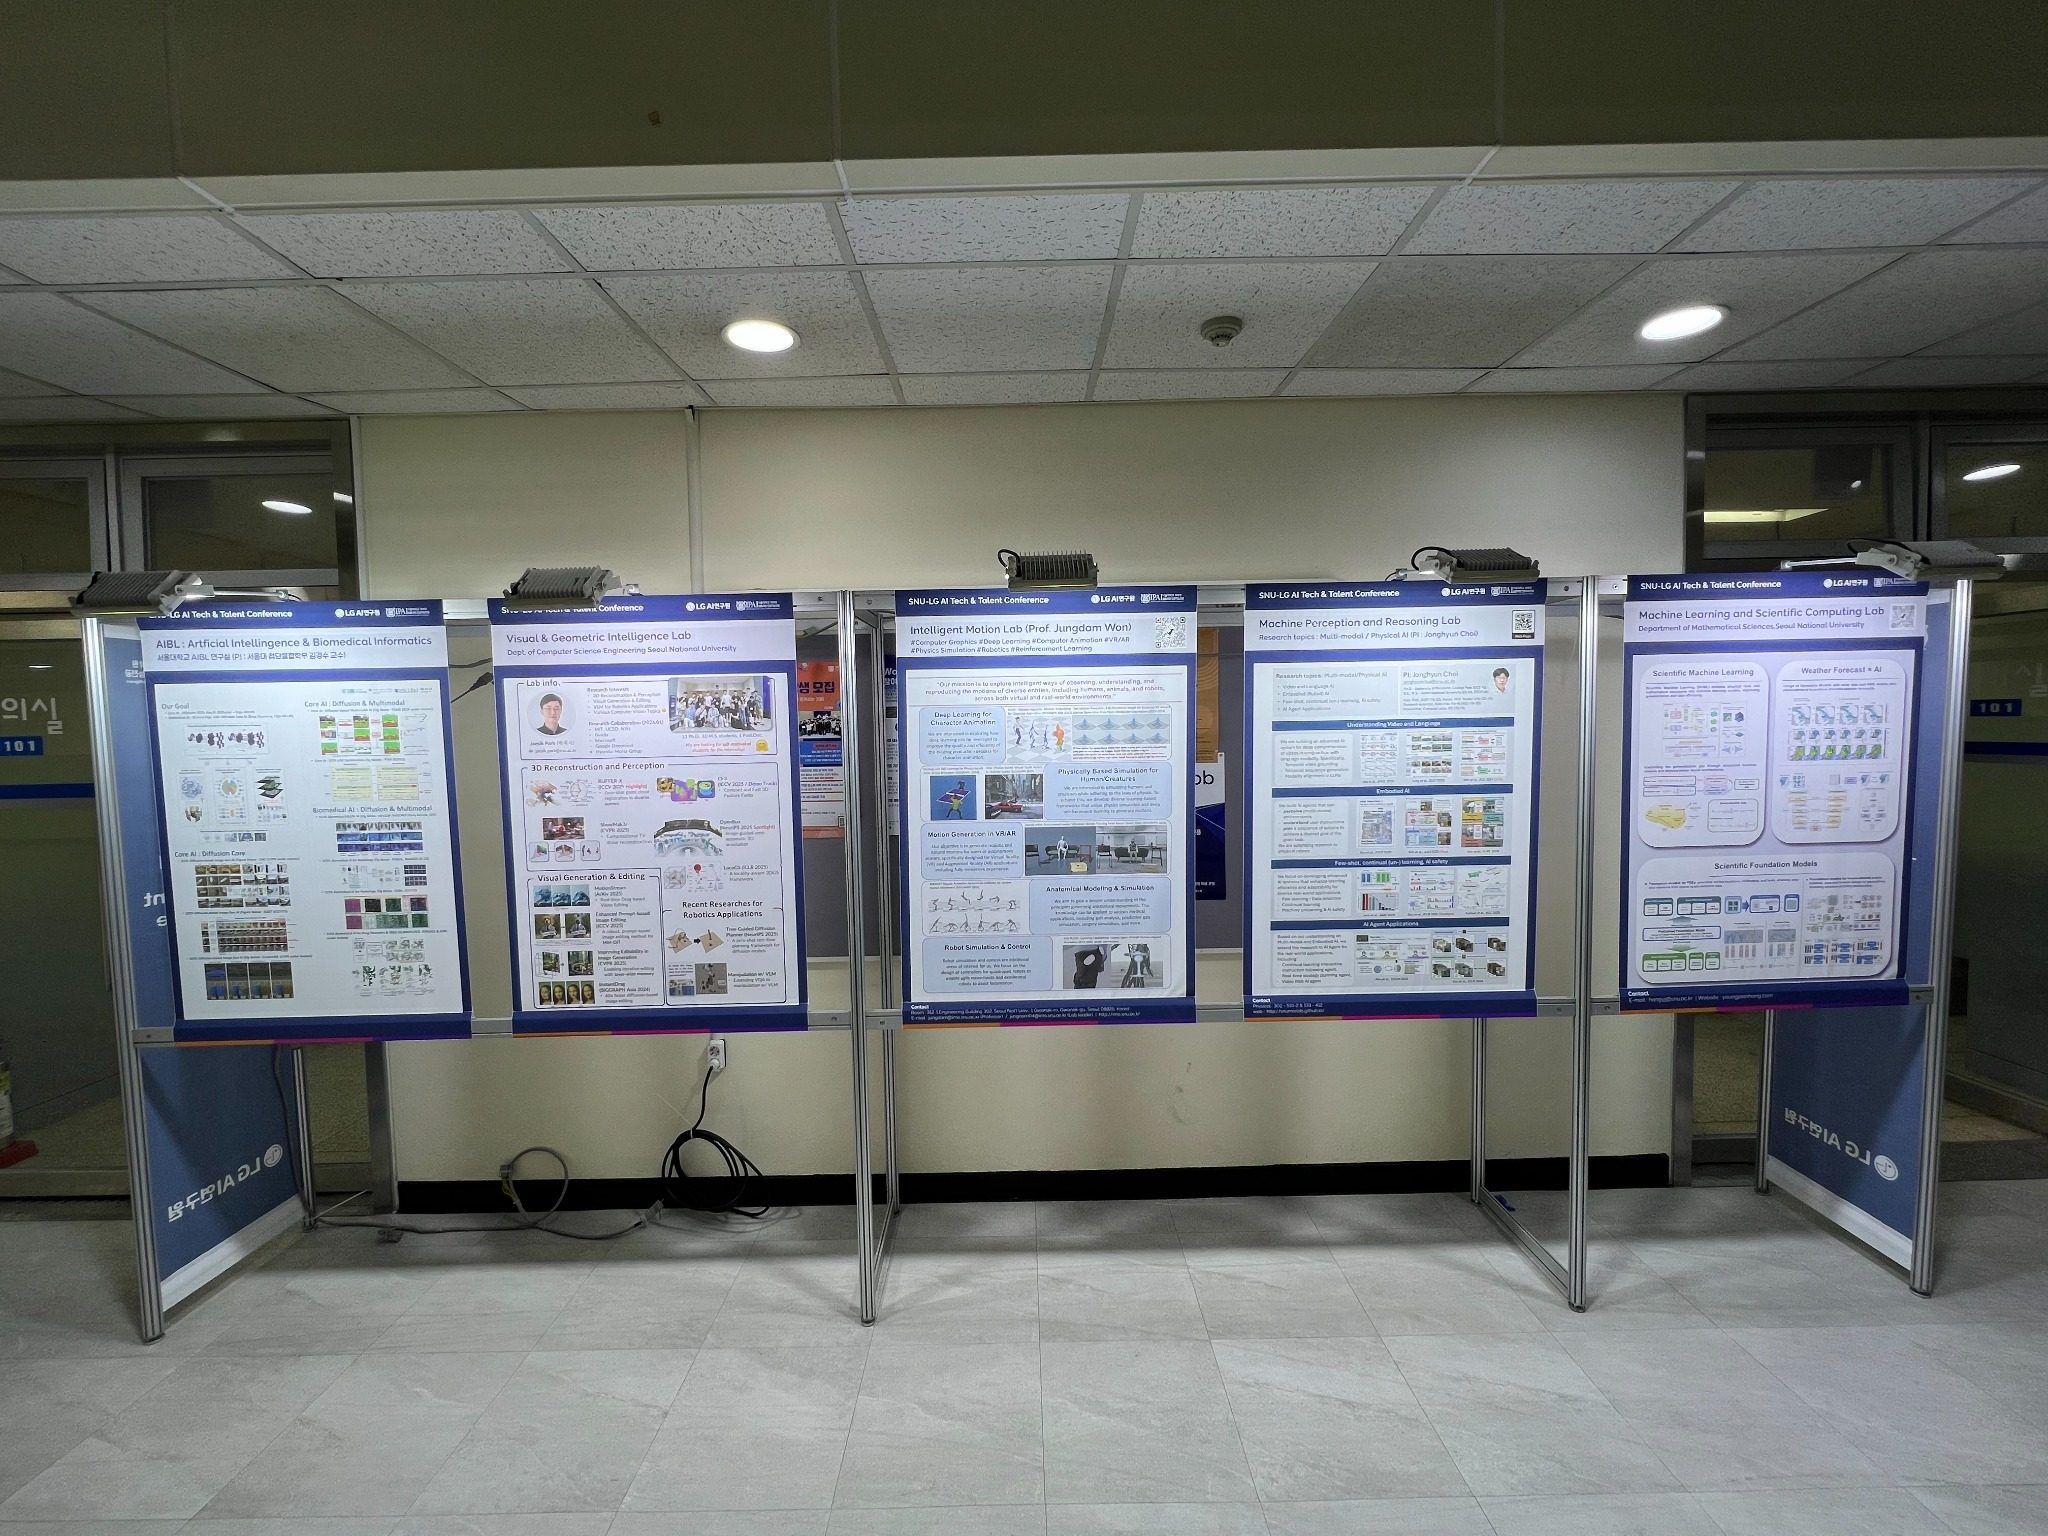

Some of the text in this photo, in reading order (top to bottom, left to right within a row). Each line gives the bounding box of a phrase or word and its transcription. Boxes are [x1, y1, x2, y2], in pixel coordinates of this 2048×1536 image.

[1736, 580, 1782, 588] Conference
[1328, 590, 1354, 598] Talent
[1354, 589, 1400, 597] Conference
[908, 598, 940, 606] SNU-LG
[978, 596, 1003, 604] Talent
[1004, 596, 1050, 604] Conference
[598, 604, 644, 612] Conference
[192, 610, 210, 618] Tech
[220, 610, 245, 618] Talent
[246, 608, 292, 618] Conference
[1640, 606, 1884, 620] Machine Learning and Scientific Computing Lab
[1260, 616, 1461, 629] Machine Perception and Reasoning Lab
[1692, 624, 1741, 632] Mathematical
[1830, 622, 1864, 630] University
[910, 622, 1132, 636] Intelligent Motion Lab (Prof. Jungdam Won)
[506, 630, 692, 643] Visual Geometric Intelligence Lab
[1320, 632, 1364, 640] Multi-modal
[1370, 632, 1401, 640] Physical
[1424, 631, 1458, 639] Jonghyun
[156, 640, 180, 649] AIBL
[312, 637, 372, 646] Biomedical
[374, 636, 432, 646] Informatics
[910, 638, 948, 646] #Computer
[948, 638, 978, 646] Graphics
[978, 638, 1001, 646] #Deep
[1002, 638, 1030, 646] Learning
[1032, 636, 1069, 645] #Computer
[1070, 636, 1102, 644] Animation
[536, 648, 572, 656] Computer
[603, 646, 646, 654] Engineering
[940, 646, 976, 654] Simulation
[1063, 644, 1092, 652] Learning
[1721, 668, 1754, 676] Learning
[1833, 666, 1866, 674] Forecast
[812, 681, 836, 694] 모집
[332, 700, 361, 708] Diffusion
[1979, 702, 2013, 713] 101
[1346, 722, 1387, 730] Understanding
[4, 740, 36, 752] 101
[544, 762, 665, 771] Reconstruction and Perception
[1058, 768, 1090, 776] Physically
[312, 806, 347, 814] Biomedical
[396, 804, 433, 812] Multimodal
[202, 850, 230, 858] Diffusion
[1432, 858, 1448, 866] safety
[1792, 860, 1818, 868] Models
[538, 872, 646, 882] Visual Generation Editing
[1120, 884, 1154, 892] Simulation
[682, 900, 751, 908] Recent Researches
[716, 910, 762, 919] Applications
